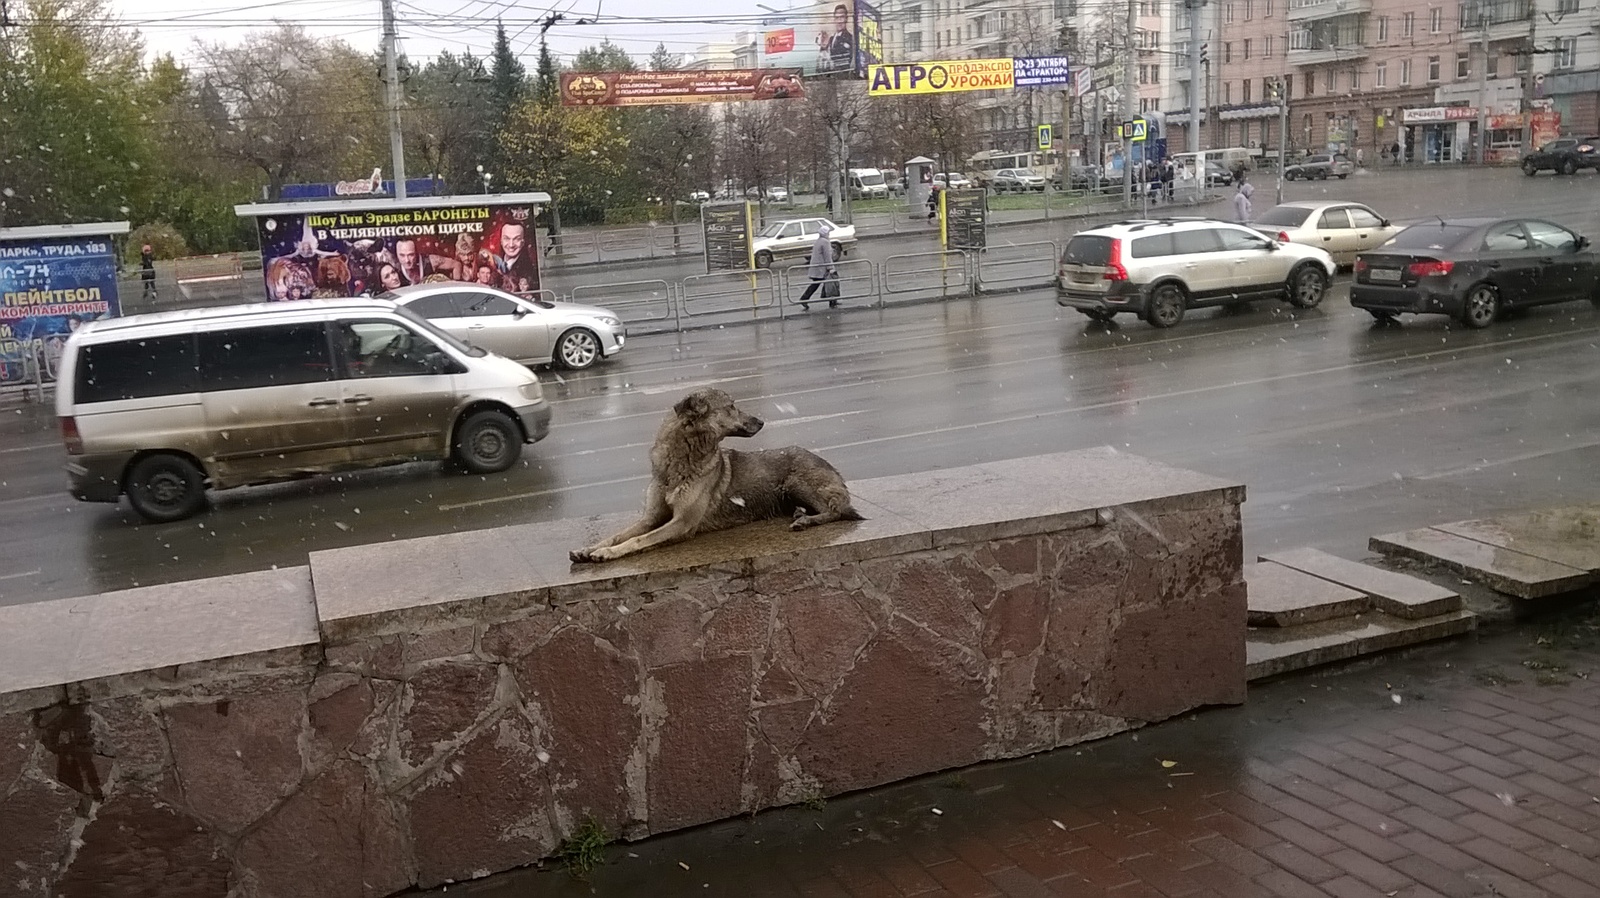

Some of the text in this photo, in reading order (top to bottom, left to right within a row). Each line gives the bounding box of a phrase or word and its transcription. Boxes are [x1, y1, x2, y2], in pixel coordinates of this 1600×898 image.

[949, 61, 1012, 75] ПРОДЭКСПО
[1014, 57, 1067, 69] 20-23 ОКТЯБРЯ
[1026, 67, 1068, 77] «ТРАКТОР»
[308, 215, 337, 229] Шоу
[365, 212, 411, 227] Эрадзе
[413, 208, 490, 222] БАРОНЕТЫ
[318, 222, 484, 241] В ЧЕЛЯБИНСКОМ ЦИРКЕ
[42, 244, 85, 257] ТРУДА,
[86, 243, 107, 254] 183
[4, 287, 101, 306] ПЕЙНТБОЛ
[31, 302, 108, 316] ЛАБИРИНТЕ
